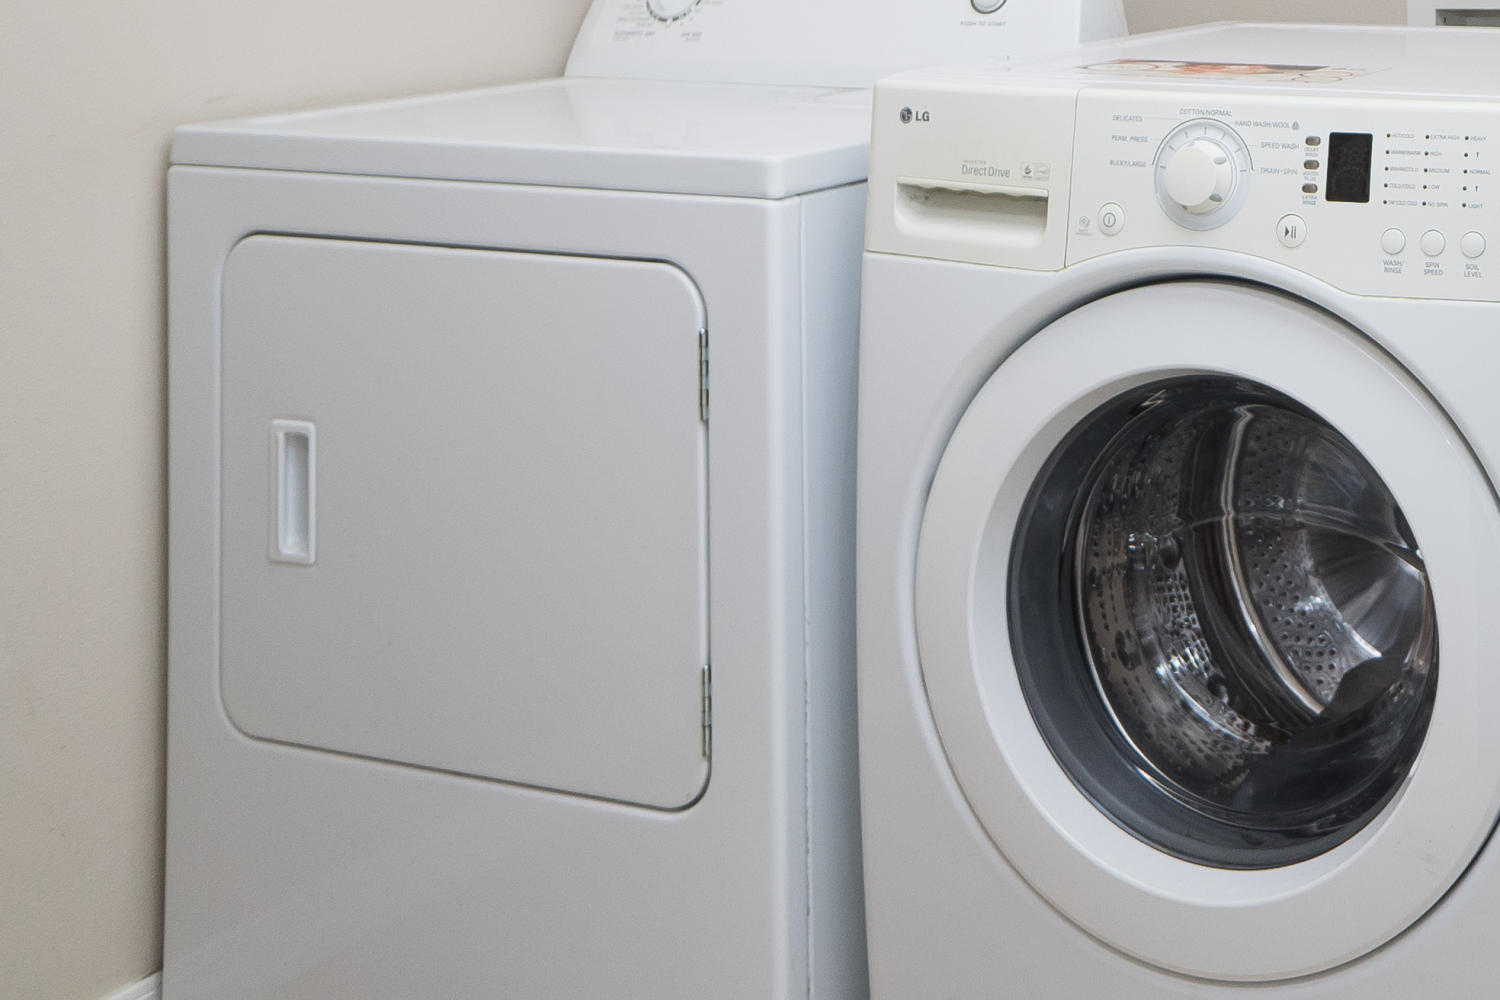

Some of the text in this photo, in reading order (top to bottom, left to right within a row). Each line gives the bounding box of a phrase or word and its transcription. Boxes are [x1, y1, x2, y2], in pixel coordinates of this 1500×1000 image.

[915, 110, 931, 122] LG
[1179, 108, 1233, 118] COTTON/NORMAL
[1112, 114, 1143, 122] DELICATES
[1130, 135, 1148, 143] PRESS
[1425, 261, 1440, 269] SPIN
[1465, 263, 1479, 271] SOIL
[1384, 266, 1402, 274] RINSE
[1424, 268, 1444, 276] SPEED
[1464, 270, 1483, 278] LEVEL
